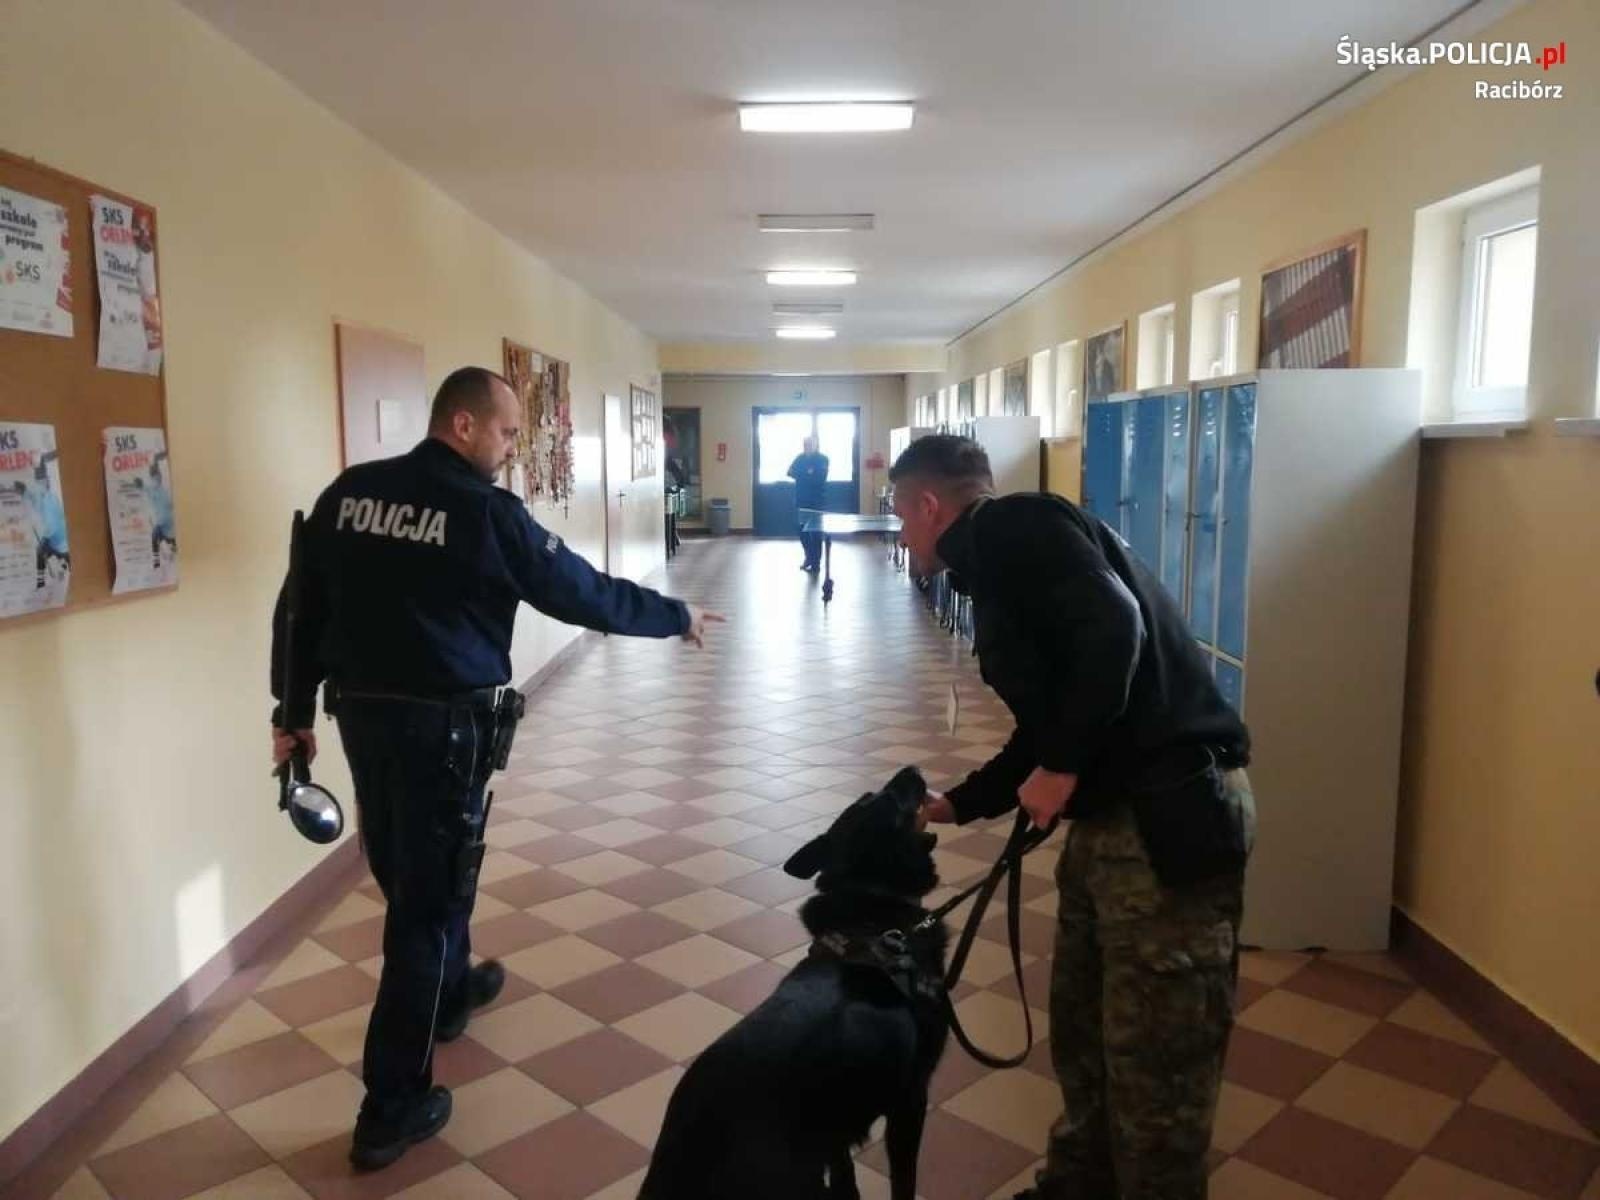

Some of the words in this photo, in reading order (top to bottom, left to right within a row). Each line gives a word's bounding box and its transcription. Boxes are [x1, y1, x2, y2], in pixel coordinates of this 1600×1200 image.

[101, 206, 124, 225] SKS
[15, 260, 41, 281] SKS
[0, 430, 19, 450] KS
[114, 433, 137, 453] SKS
[336, 496, 448, 547] POLICJA
